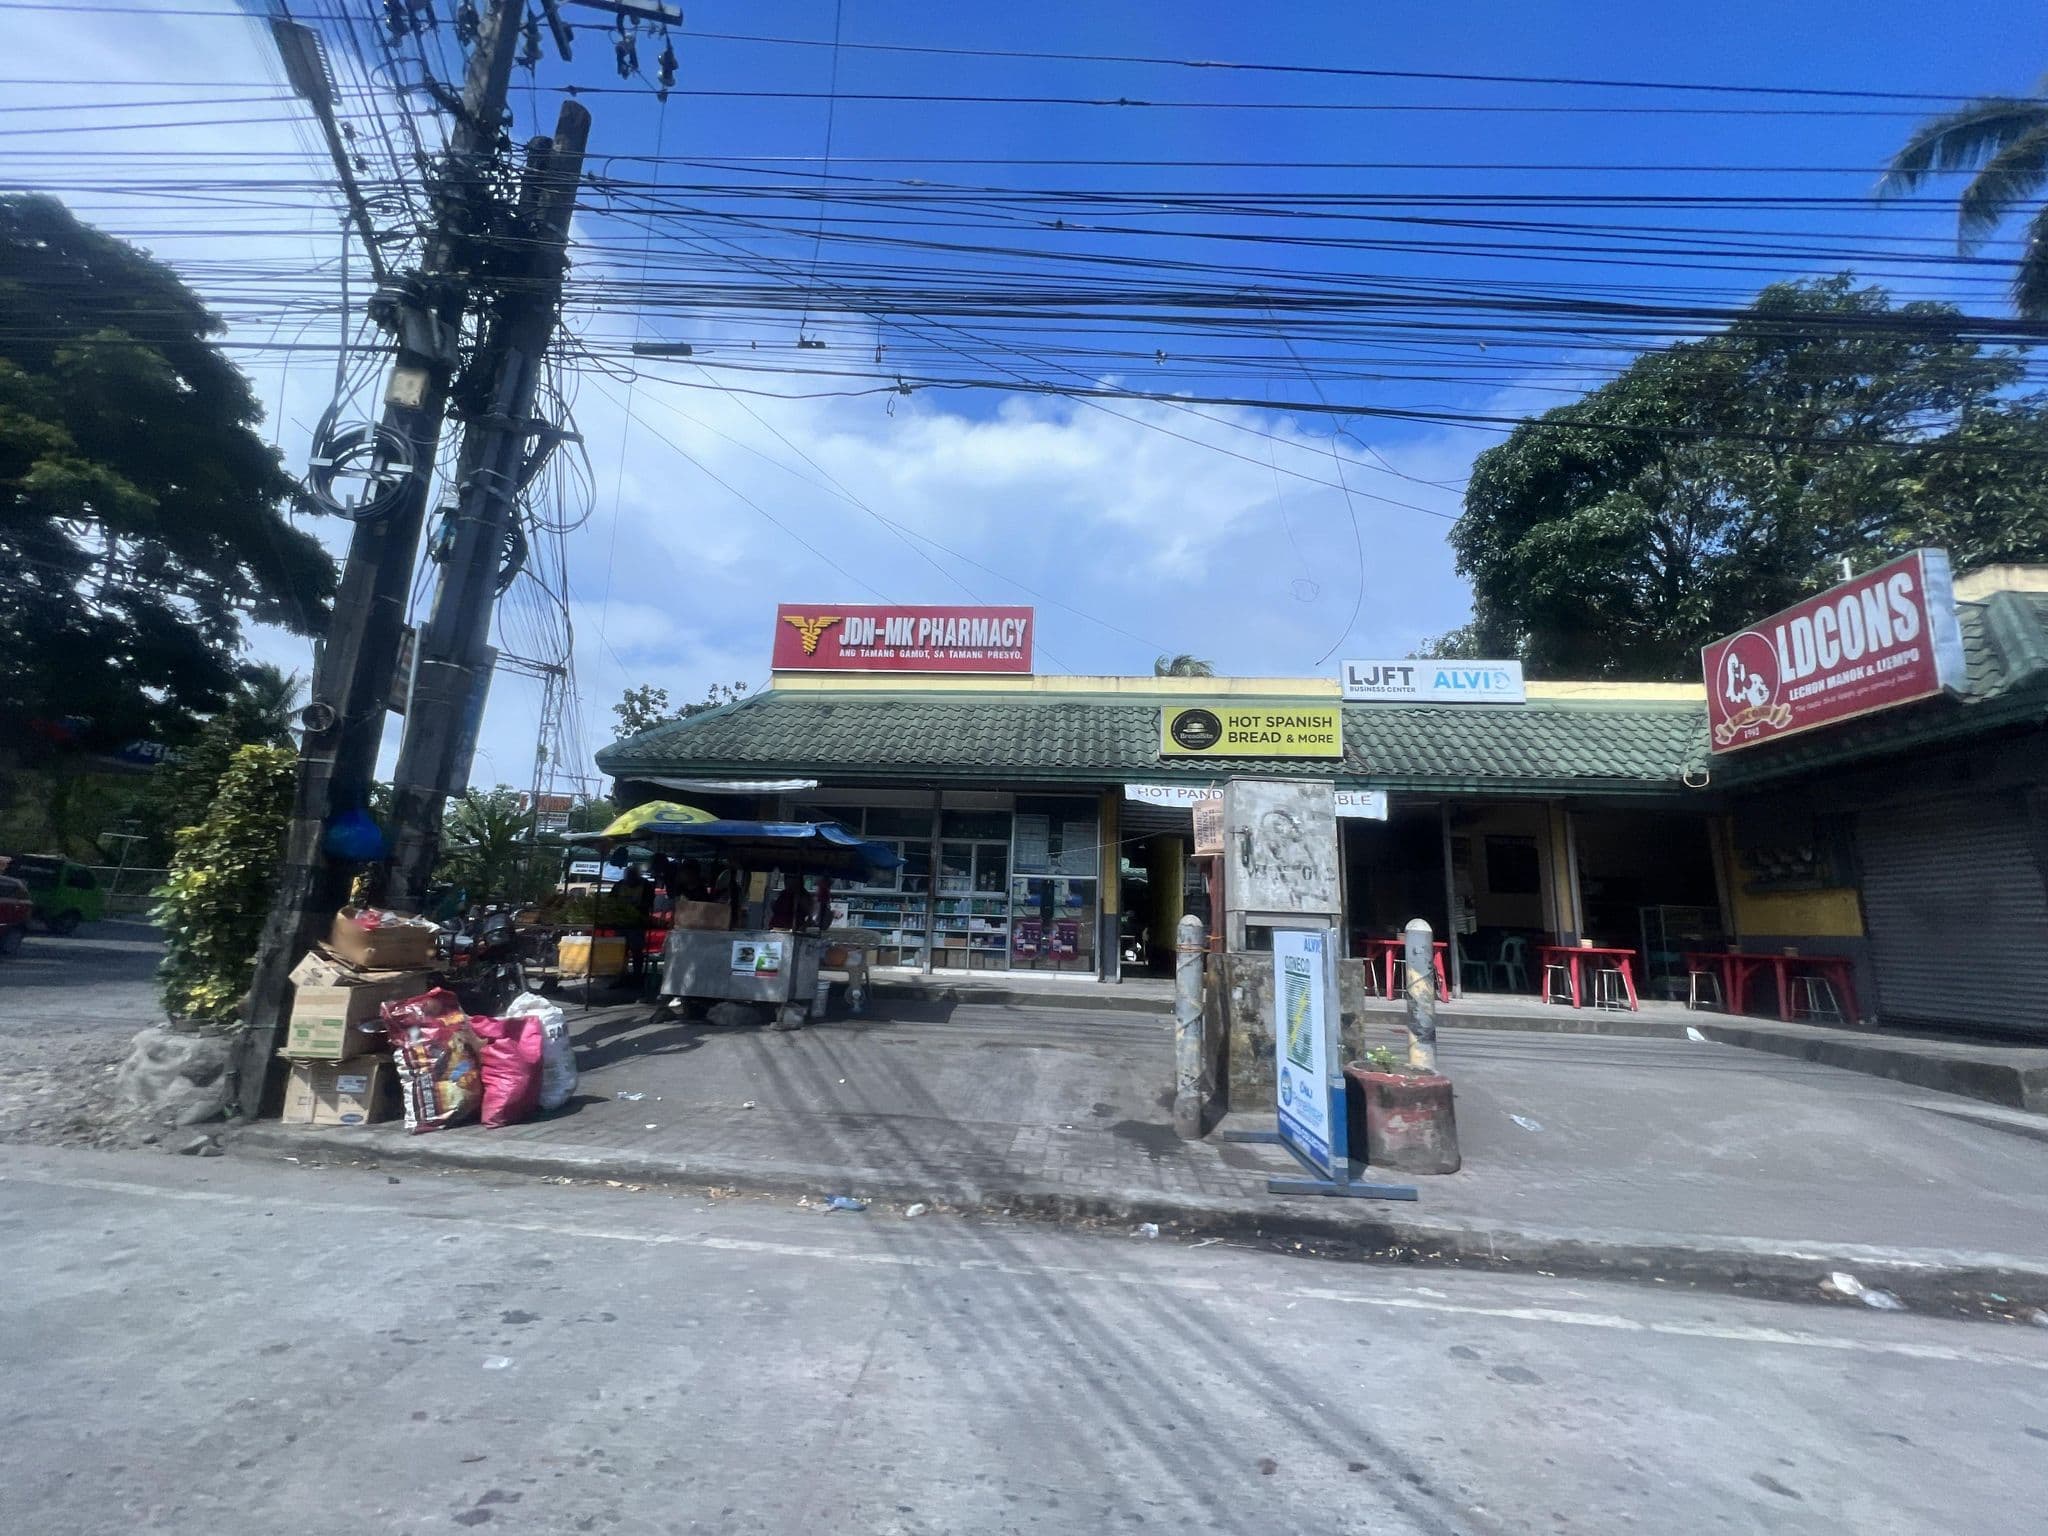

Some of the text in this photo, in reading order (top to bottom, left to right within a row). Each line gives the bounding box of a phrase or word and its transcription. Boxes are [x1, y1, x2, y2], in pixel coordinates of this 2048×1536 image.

[839, 617, 1027, 647] JDN-MK PHARMACY
[1775, 572, 1920, 684] LDCONS
[839, 649, 856, 657] ANG
[860, 649, 895, 658] TAMANG
[934, 650, 945, 658] SA
[949, 650, 983, 659] TAMANG
[1348, 666, 1415, 686] LJFT
[1789, 679, 1825, 701] LECHON
[1826, 665, 1865, 689] MANOK
[1866, 665, 1875, 676] &
[1876, 647, 1920, 672] LIEMPO
[1229, 716, 1332, 728] HOT SPANISH
[1228, 732, 1334, 743] BREAD & MORE
[1137, 788, 1372, 805] HOT PAND BLE
